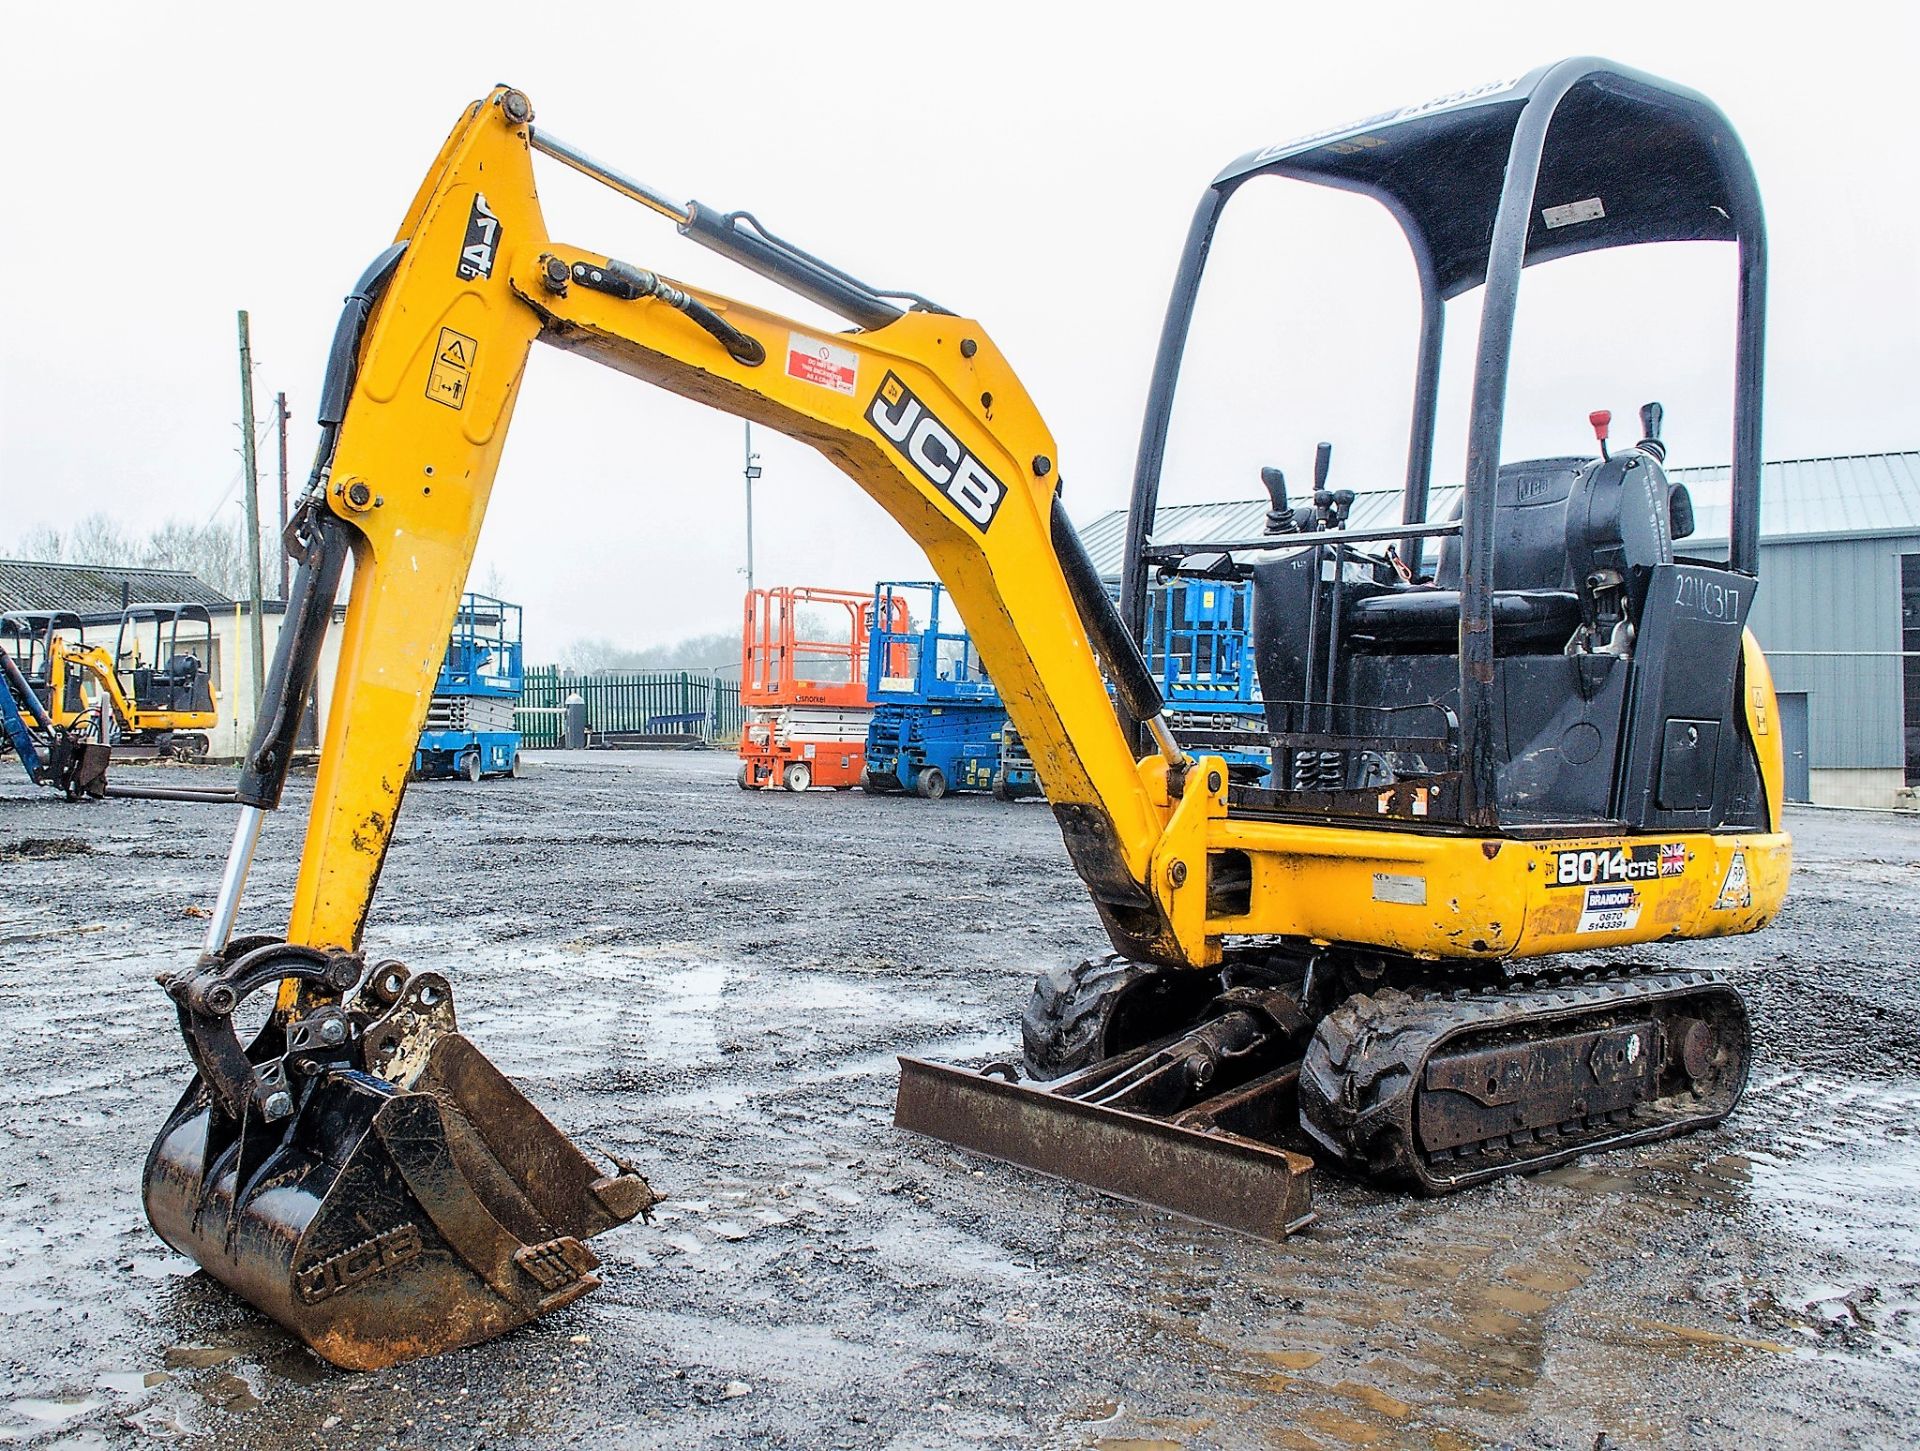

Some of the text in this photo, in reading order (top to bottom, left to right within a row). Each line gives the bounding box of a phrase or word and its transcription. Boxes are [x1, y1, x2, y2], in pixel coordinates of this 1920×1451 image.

[872, 398, 1000, 524] JCB
[1599, 912, 1623, 922] 0870
[1587, 920, 1627, 931] 5143391
